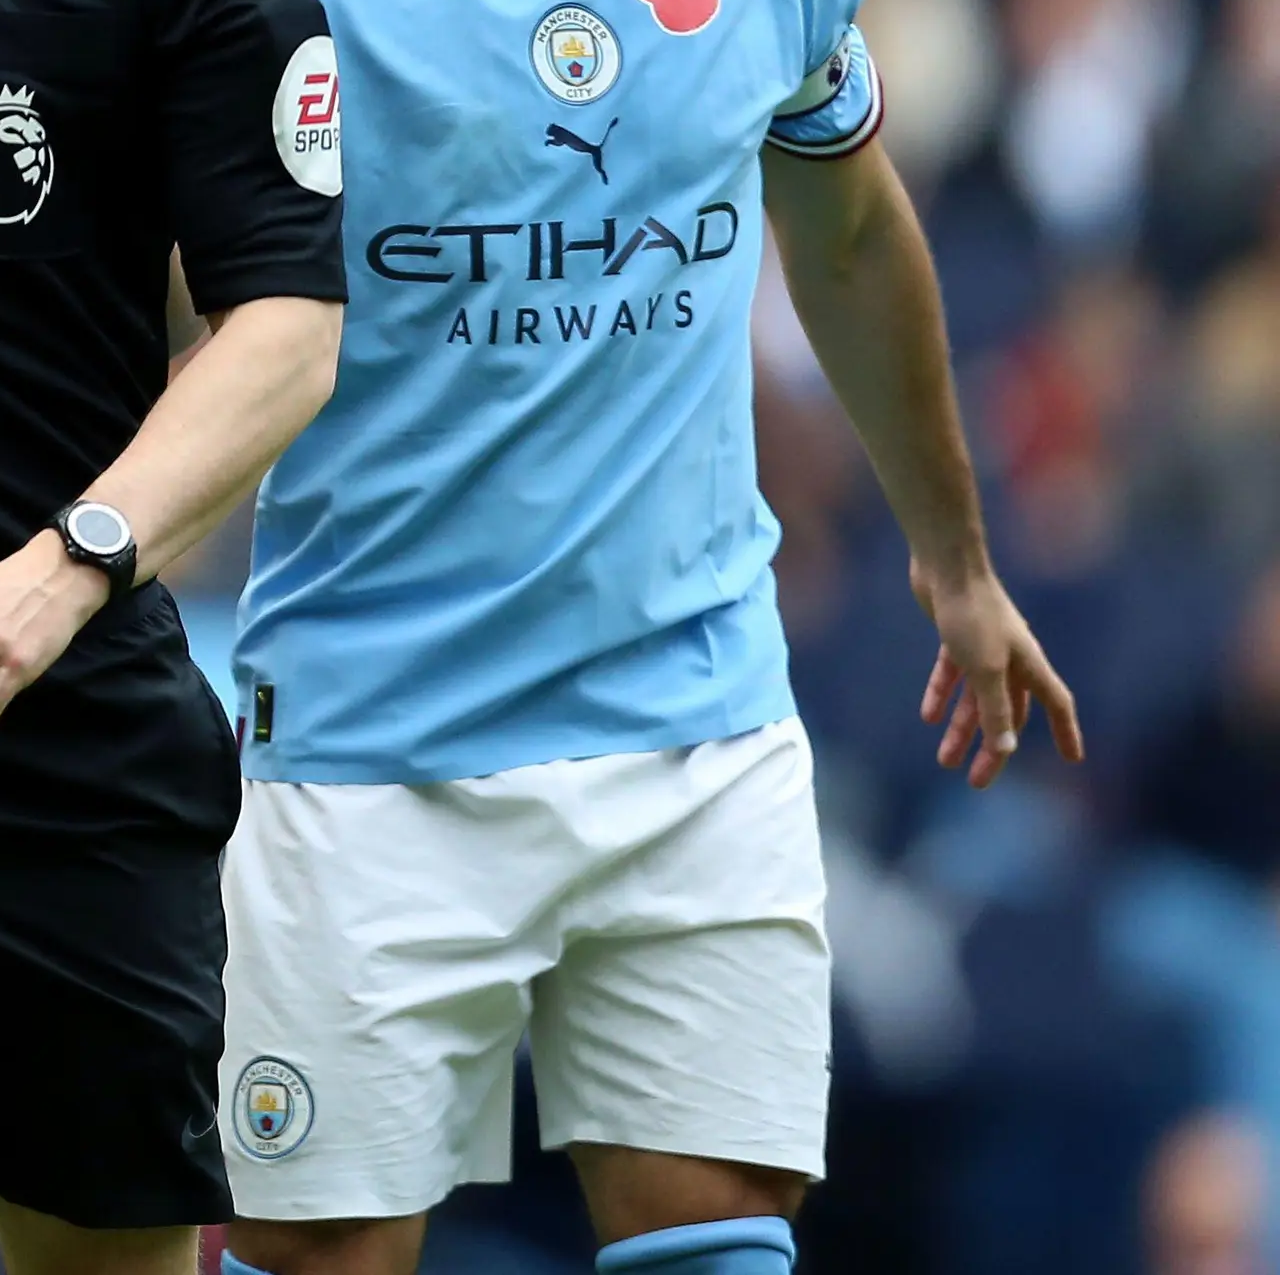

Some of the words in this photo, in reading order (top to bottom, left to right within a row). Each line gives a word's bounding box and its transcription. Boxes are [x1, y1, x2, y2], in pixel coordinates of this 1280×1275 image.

[537, 11, 607, 43] MANCHESTER
[566, 87, 592, 98] CITY
[366, 201, 738, 283] ETIHAD
[447, 290, 693, 345] AIRWAYS
